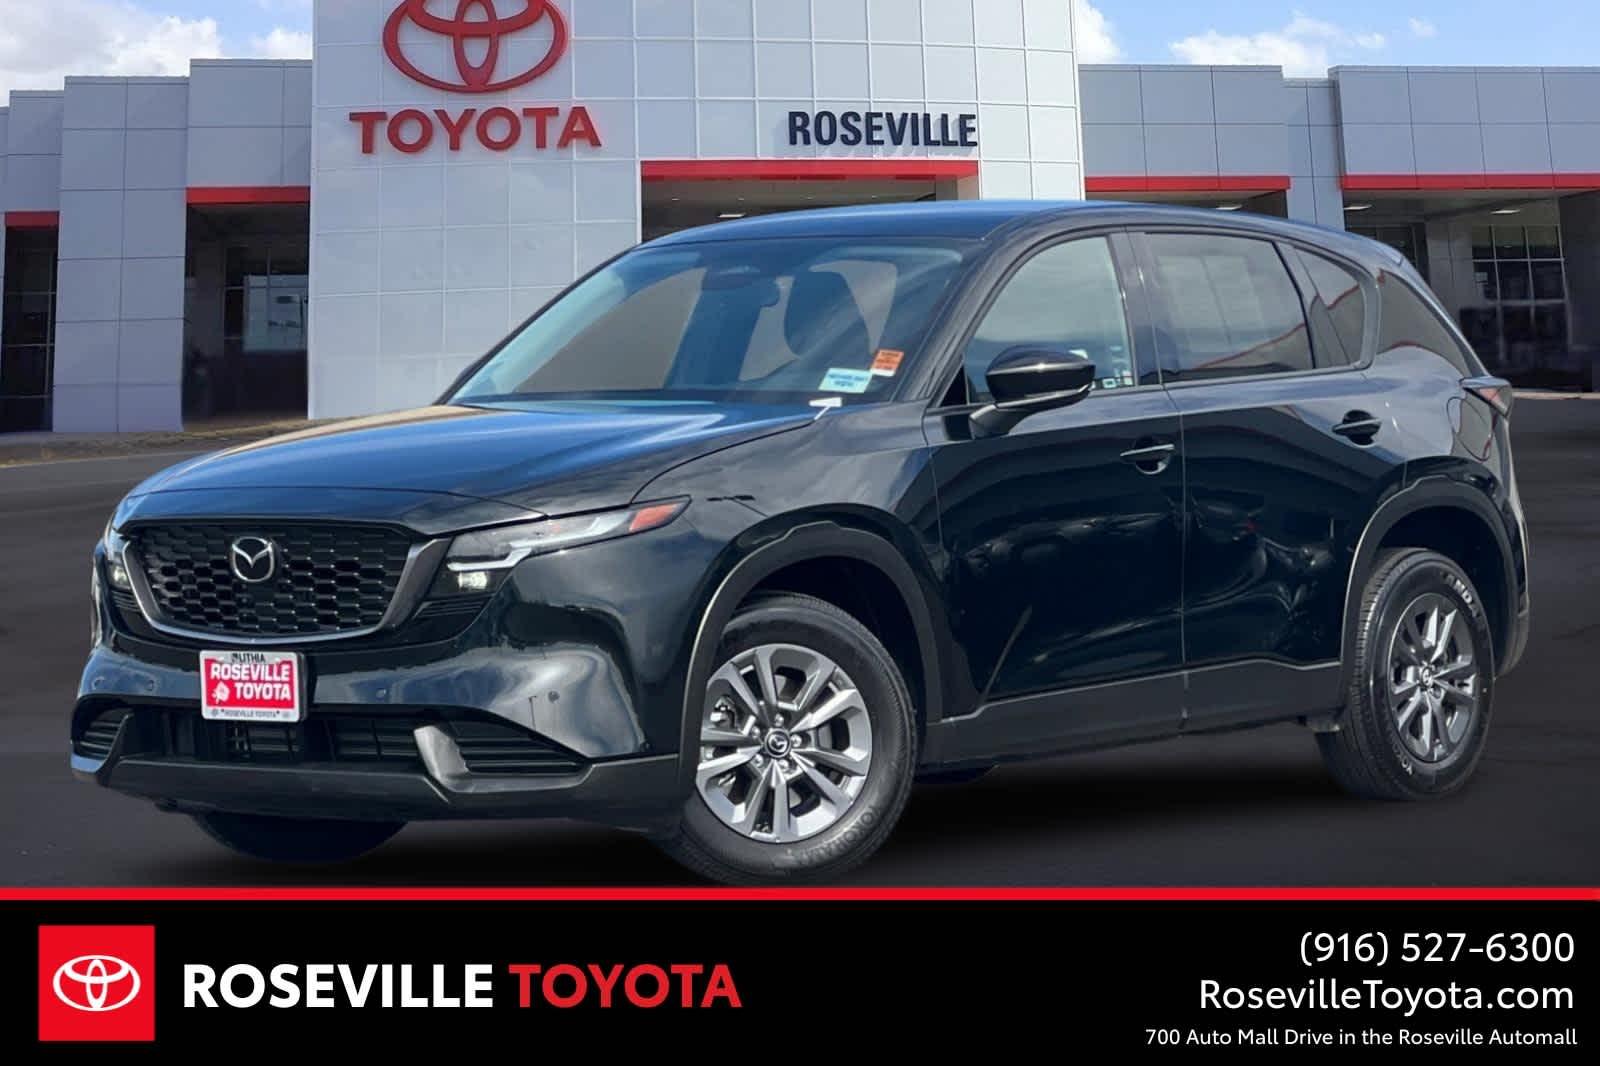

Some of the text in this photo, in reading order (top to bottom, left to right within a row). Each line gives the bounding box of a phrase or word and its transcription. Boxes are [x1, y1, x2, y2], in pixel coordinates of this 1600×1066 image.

[350, 106, 601, 154] TOYOTA
[789, 110, 978, 147] ROSEVILLE
[238, 652, 266, 663] LITHIA
[210, 662, 291, 681] ROSEVILLE
[234, 682, 292, 701] TOYOTA
